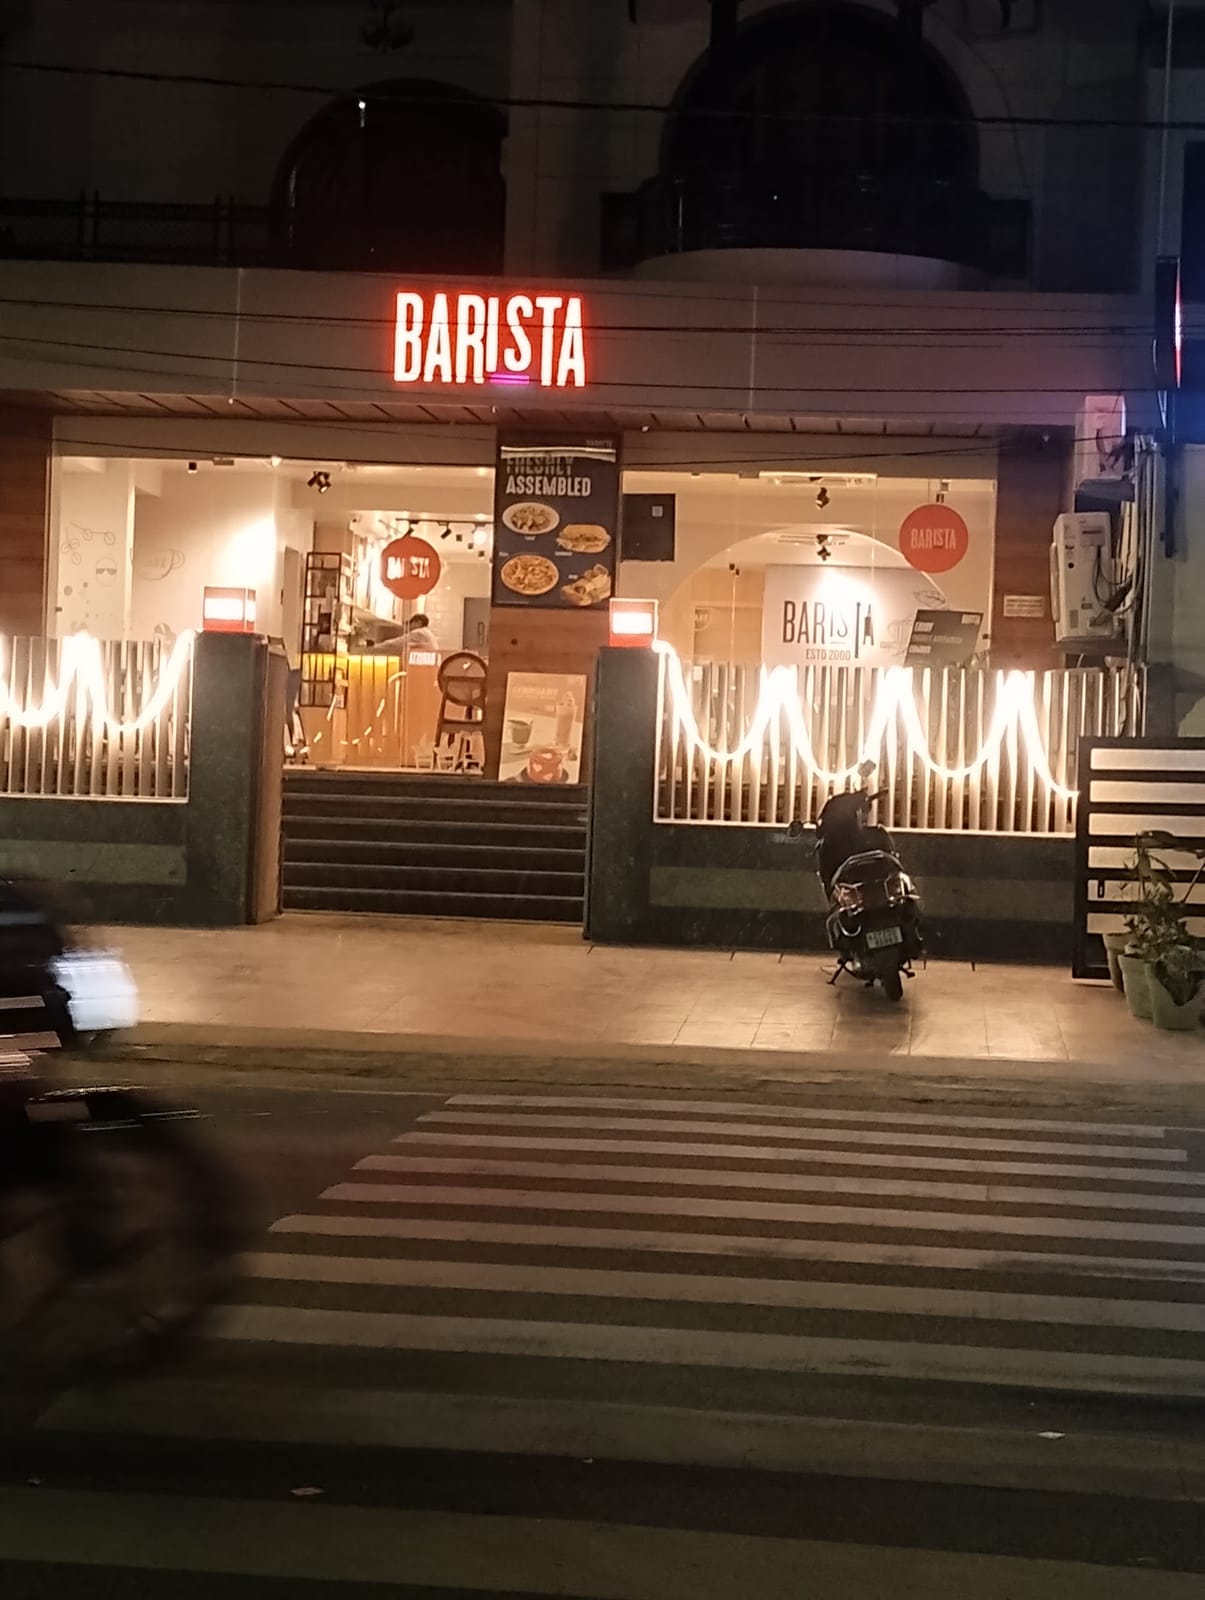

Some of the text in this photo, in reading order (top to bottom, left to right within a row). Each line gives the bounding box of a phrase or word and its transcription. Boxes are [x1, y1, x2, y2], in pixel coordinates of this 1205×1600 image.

[393, 292, 586, 387] BARISTA
[505, 475, 592, 497] ASSEMBLED
[910, 527, 957, 550] BARISTA
[805, 648, 851, 661] ESTD 2000
